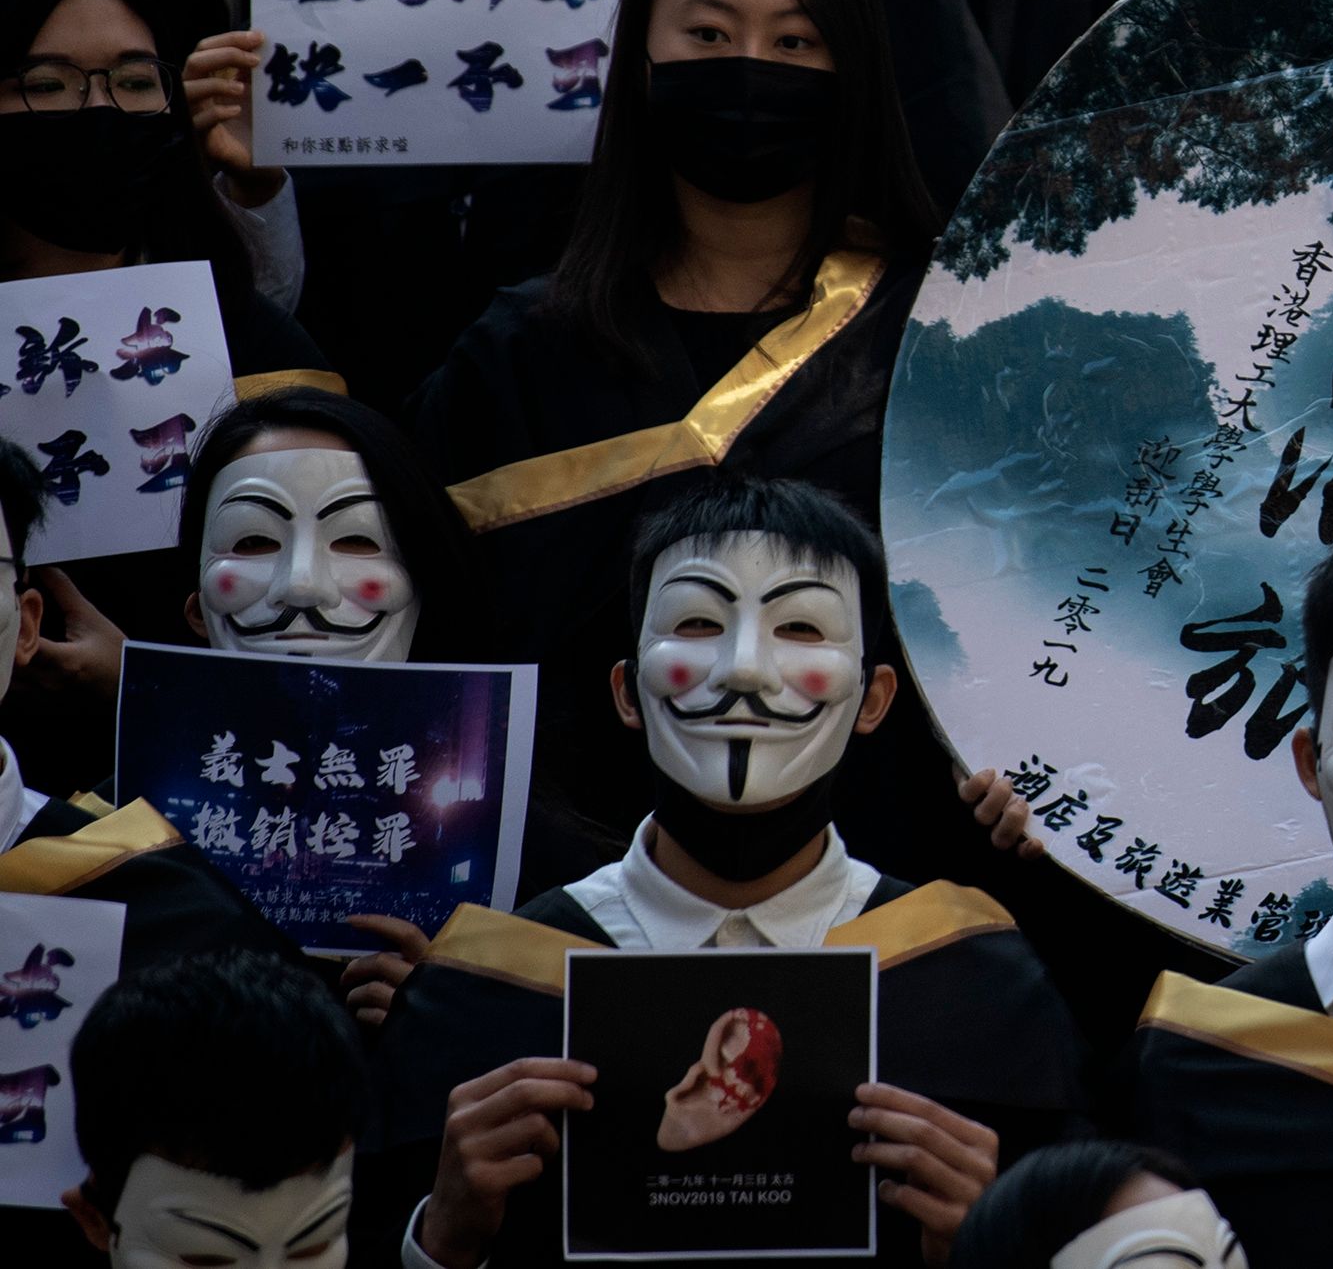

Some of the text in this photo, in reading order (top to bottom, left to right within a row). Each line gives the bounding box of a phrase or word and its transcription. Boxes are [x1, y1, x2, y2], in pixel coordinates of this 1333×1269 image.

[264, 39, 609, 112] 缺一不可
[281, 135, 409, 156] 和你逐點訴求嗌
[0, 306, 190, 399] 訴求
[1137, 240, 1333, 599] 香港理工大學學生會
[1028, 434, 1183, 688] 迎新日 二零一九
[200, 731, 421, 796] 義士無罪
[189, 801, 418, 862] 撤銷控罪
[646, 1172, 795, 1188] 二零一九年 十一月三日 太古
[648, 1189, 793, 1206] 3NOV2019 TAI KOO
